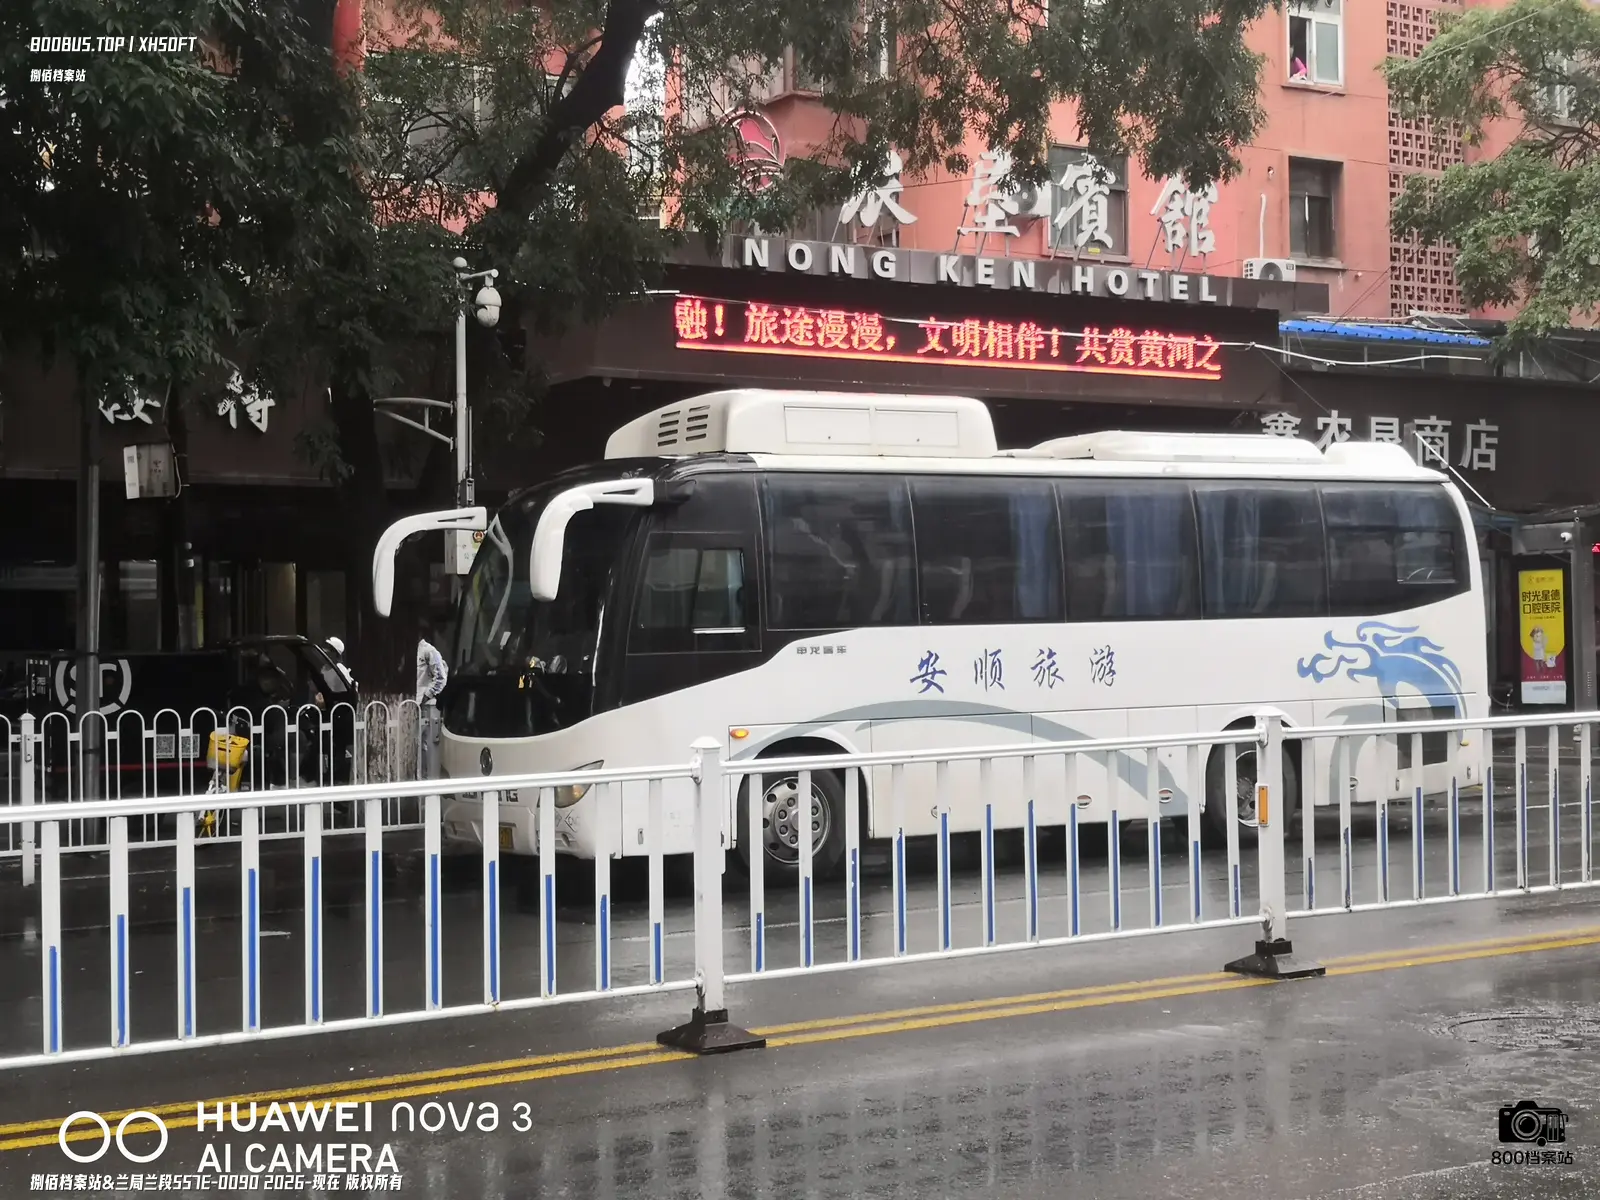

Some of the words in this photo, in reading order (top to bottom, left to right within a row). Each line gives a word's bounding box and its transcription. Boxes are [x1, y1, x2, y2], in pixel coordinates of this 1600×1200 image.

[743, 237, 897, 280] NONG
[939, 254, 1036, 289] KEN
[1072, 268, 1218, 303] HOTEL
[1522, 602, 1562, 615] 口腔医院
[909, 644, 1118, 694] 安顺旅游
